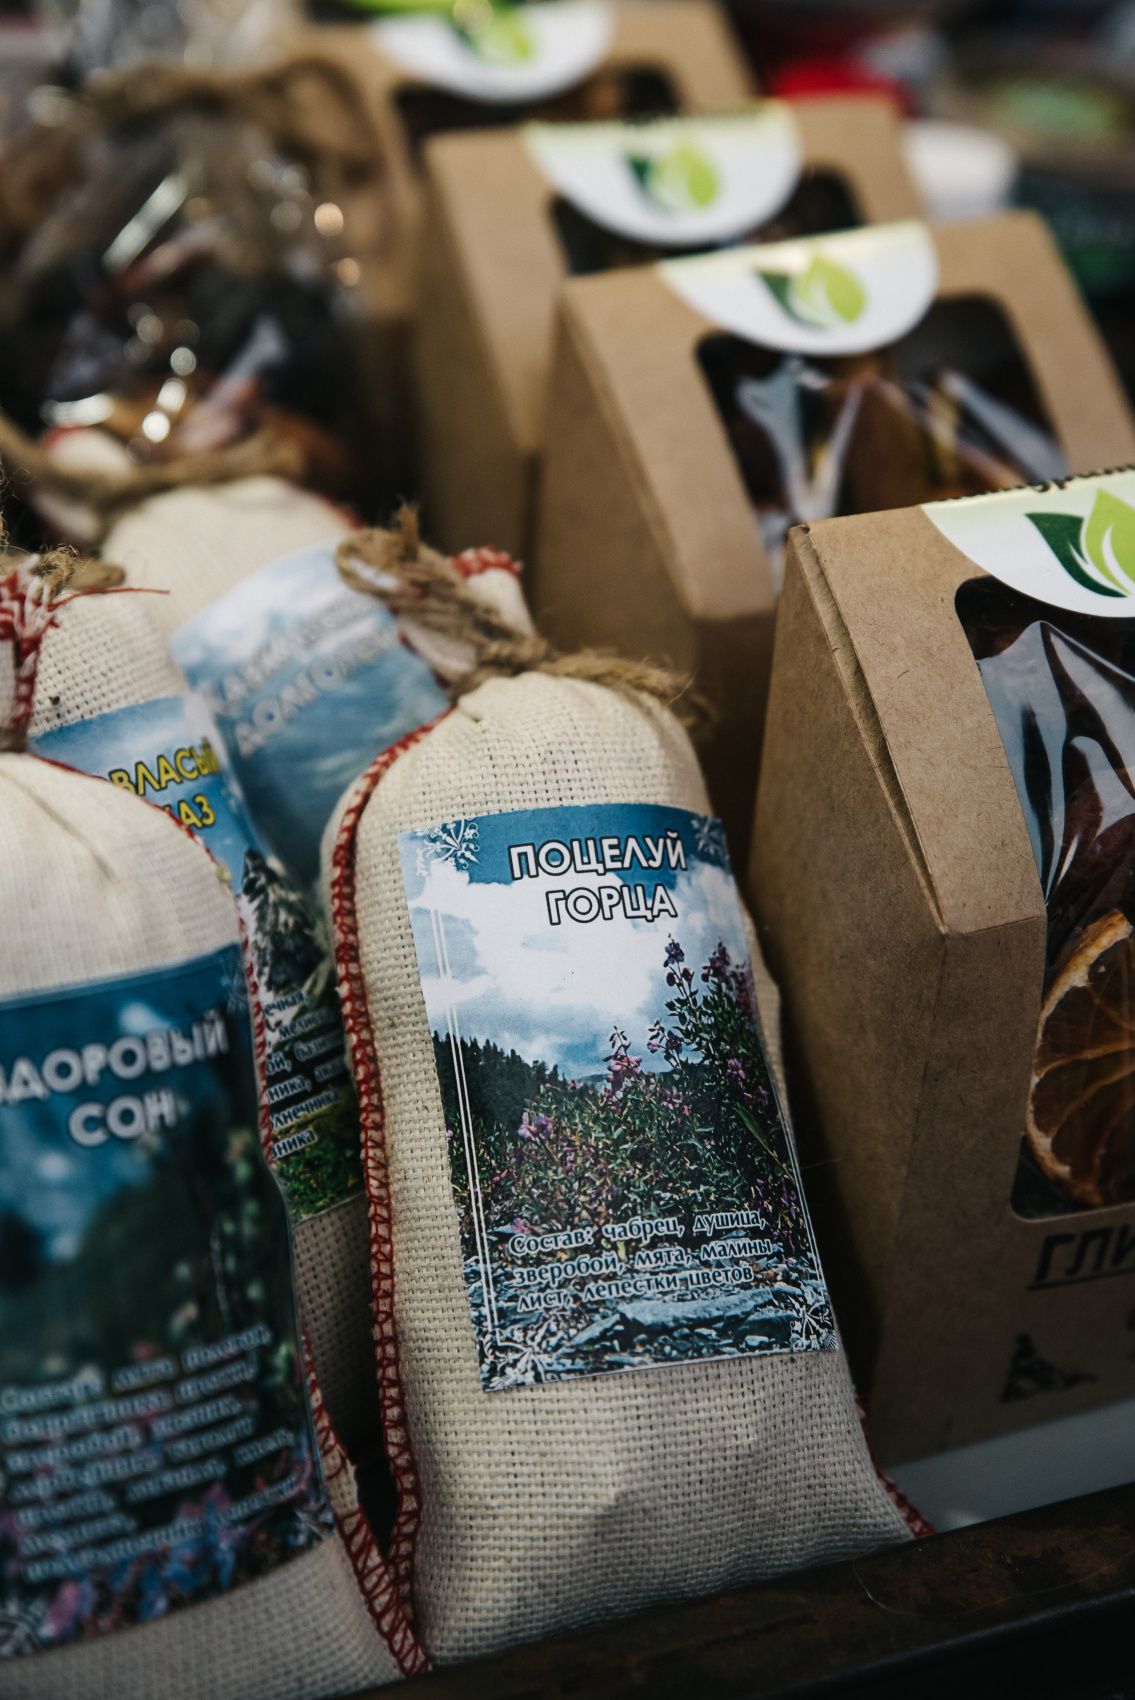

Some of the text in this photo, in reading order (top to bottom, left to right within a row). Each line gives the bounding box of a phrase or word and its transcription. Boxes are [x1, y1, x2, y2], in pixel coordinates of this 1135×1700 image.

[163, 792, 216, 830] АЗ
[508, 829, 688, 880] ПОЦЕЛУЙ
[545, 884, 678, 926] ГОРЦА
[0, 1007, 229, 1105] ДОРОВЫЙ
[68, 1087, 177, 1148] СОН
[510, 1210, 766, 1256] Состав: чабрец, душица,
[513, 1238, 773, 1287] зверобой, мята, малины
[517, 1265, 755, 1313] лист, лепестки цветов
